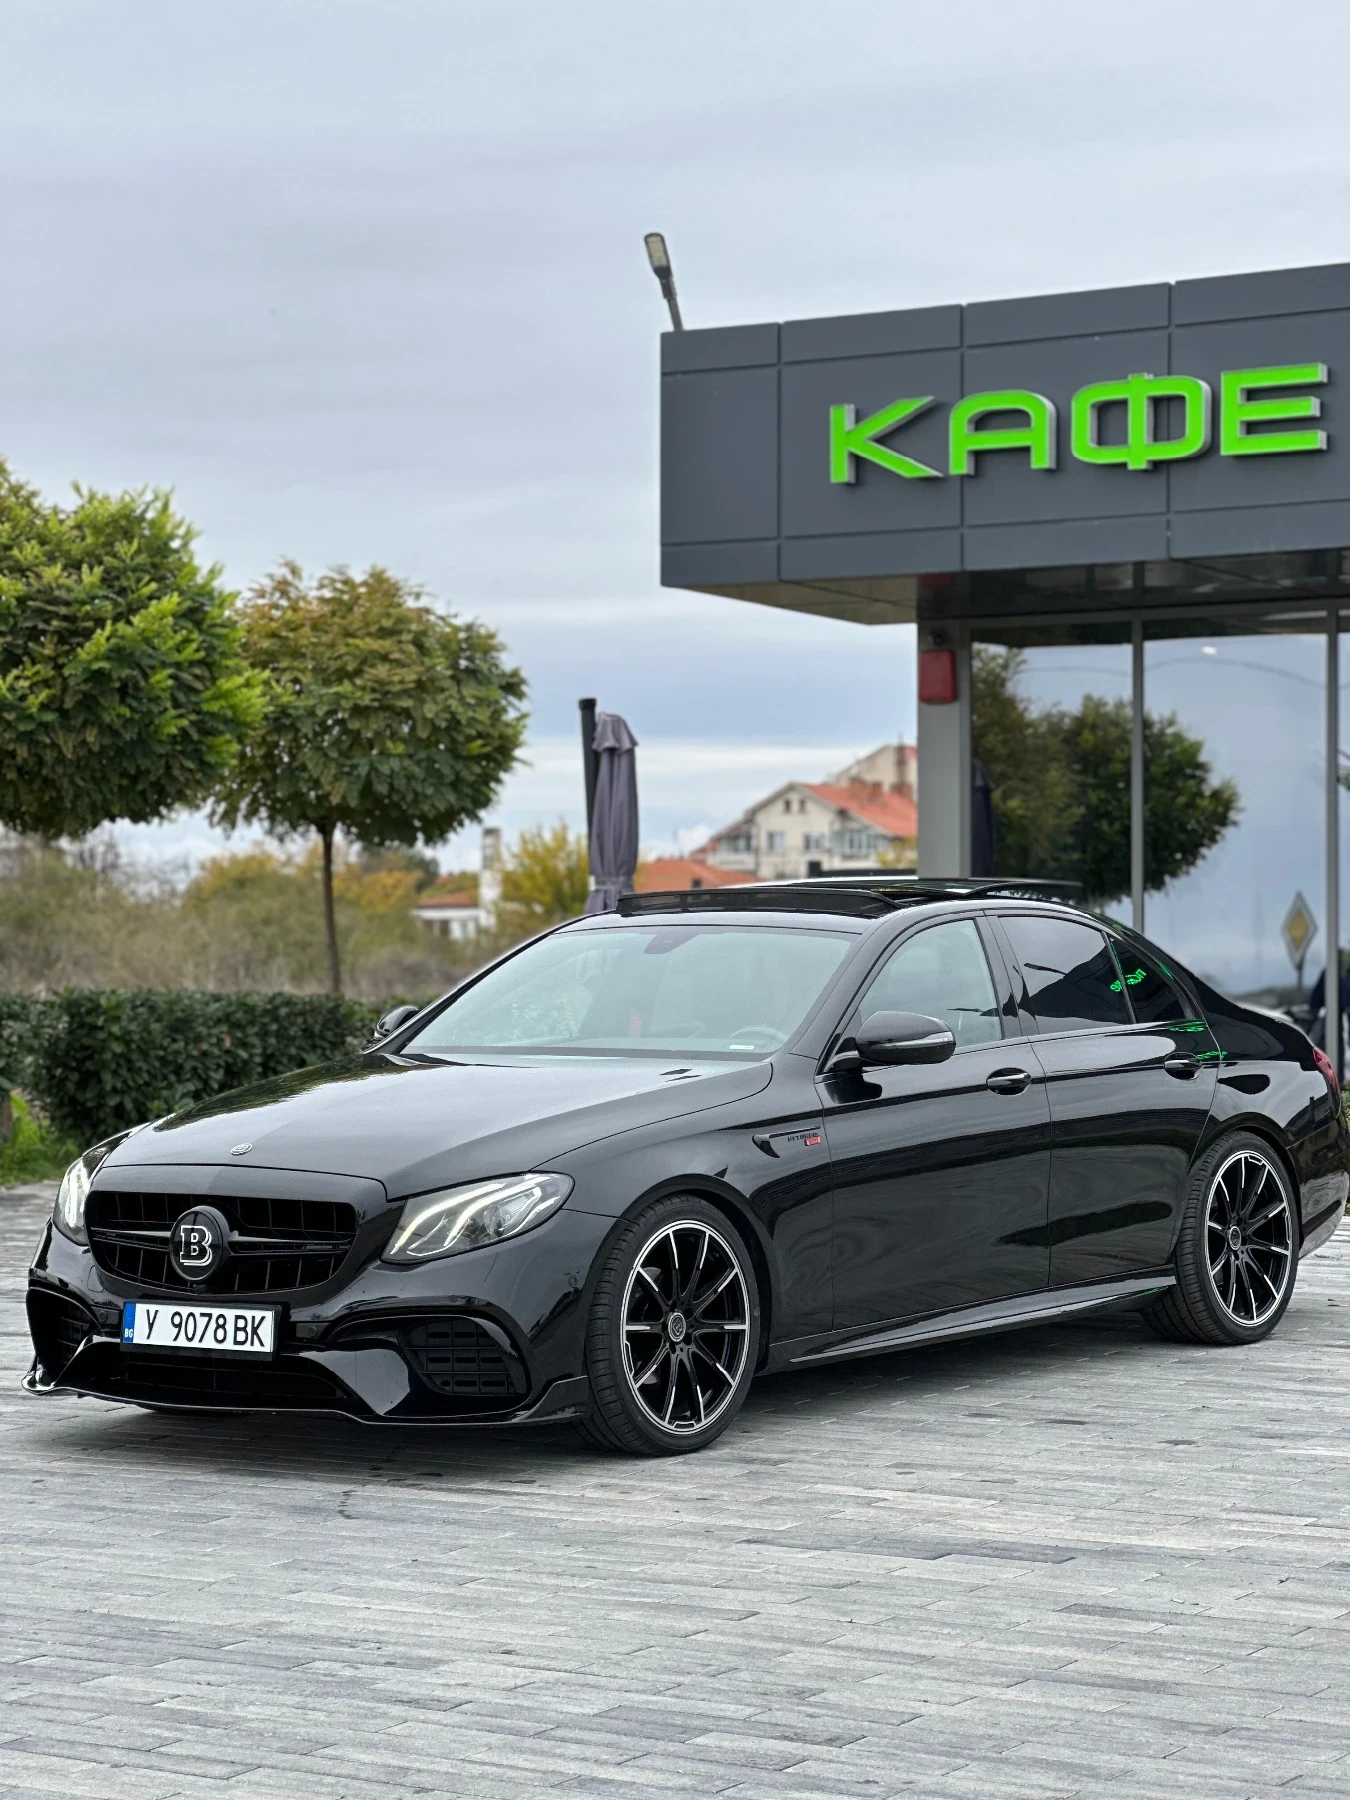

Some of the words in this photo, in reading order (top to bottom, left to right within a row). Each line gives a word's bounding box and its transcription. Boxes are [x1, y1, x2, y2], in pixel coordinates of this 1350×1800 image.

[829, 362, 1328, 484] КАФЕ
[180, 1225, 213, 1266] B
[124, 1328, 134, 1338] BG
[170, 1311, 227, 1344] 9078
[233, 1314, 266, 1347] BK
